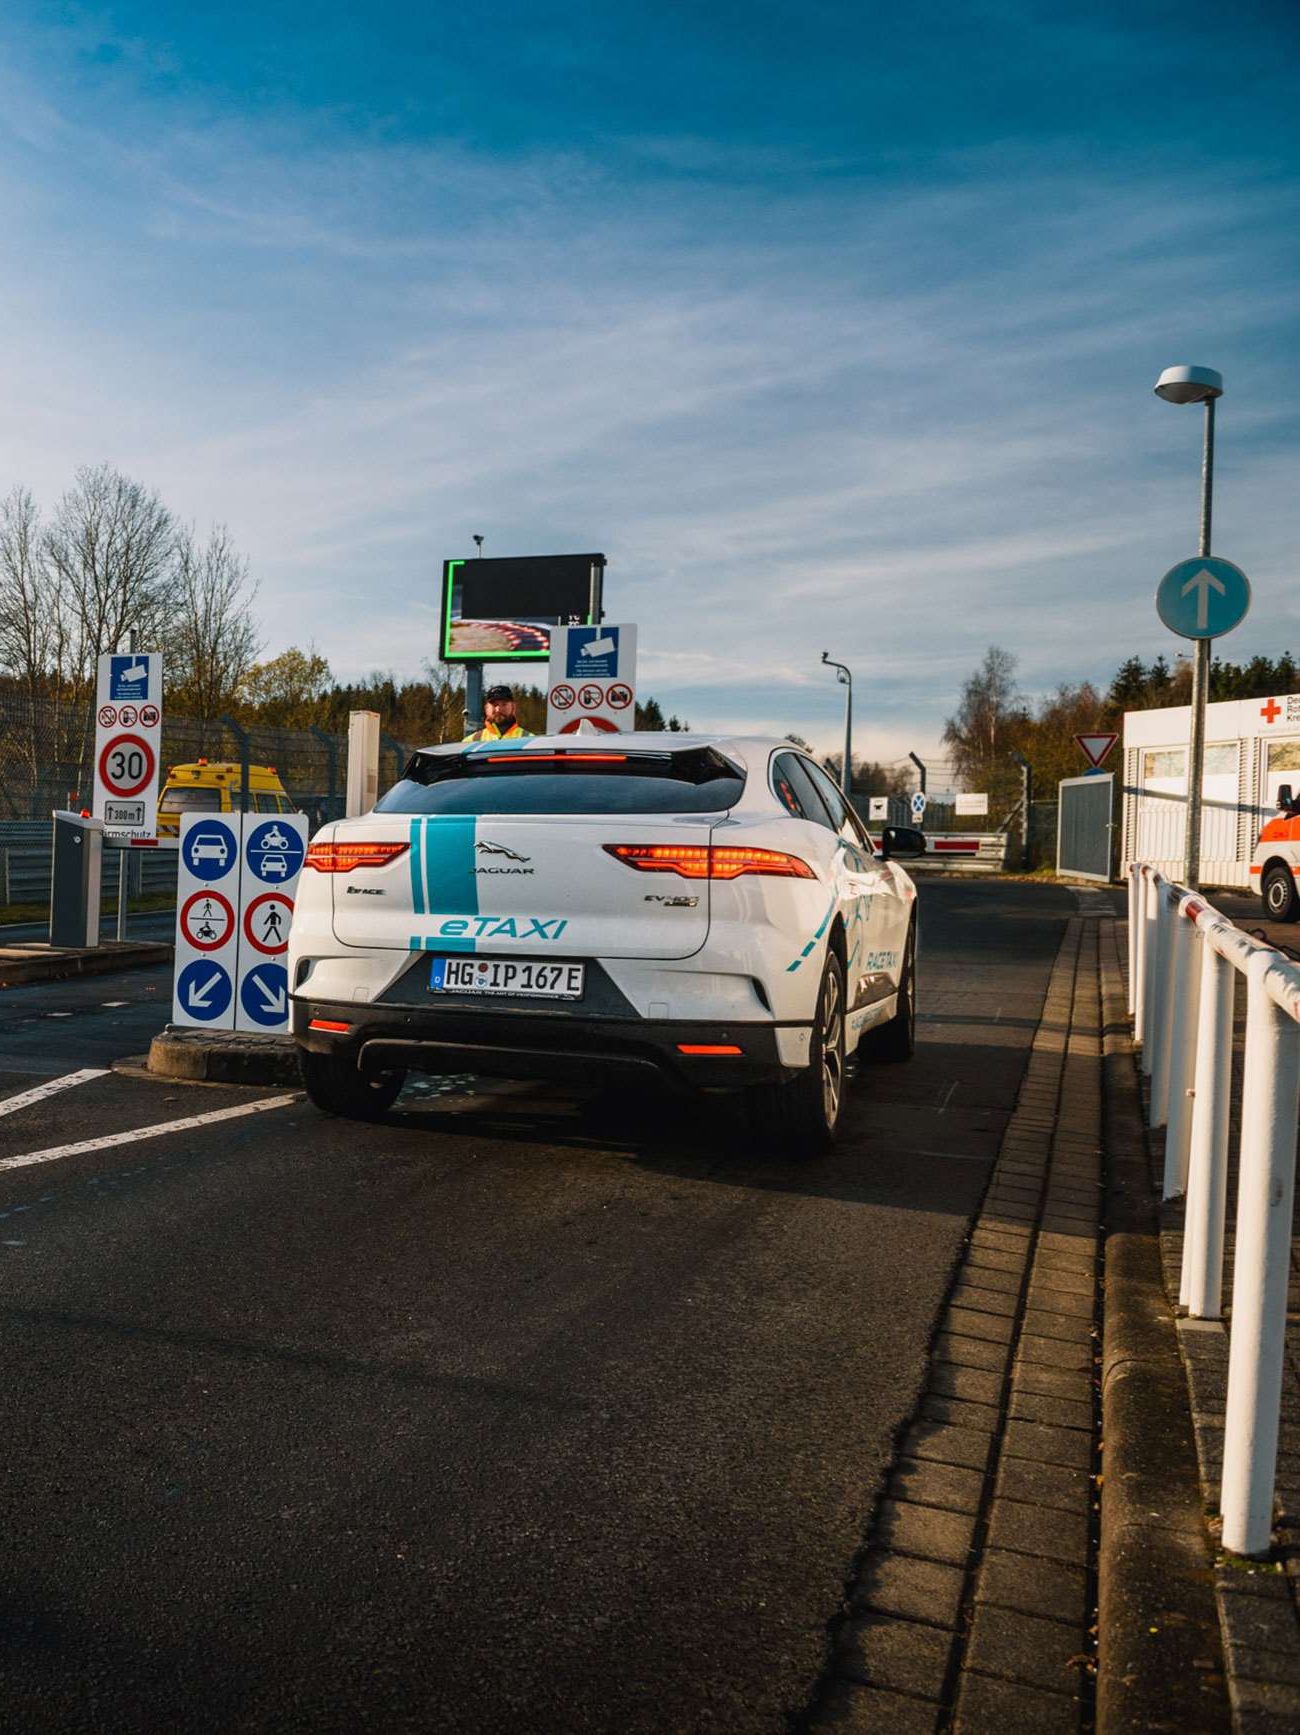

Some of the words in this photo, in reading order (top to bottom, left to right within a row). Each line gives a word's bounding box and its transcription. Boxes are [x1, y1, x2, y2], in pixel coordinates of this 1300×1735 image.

[111, 751, 143, 780] 30
[468, 867, 535, 875] JAGUAR
[439, 916, 568, 940] eTAXI
[446, 962, 474, 986] HG
